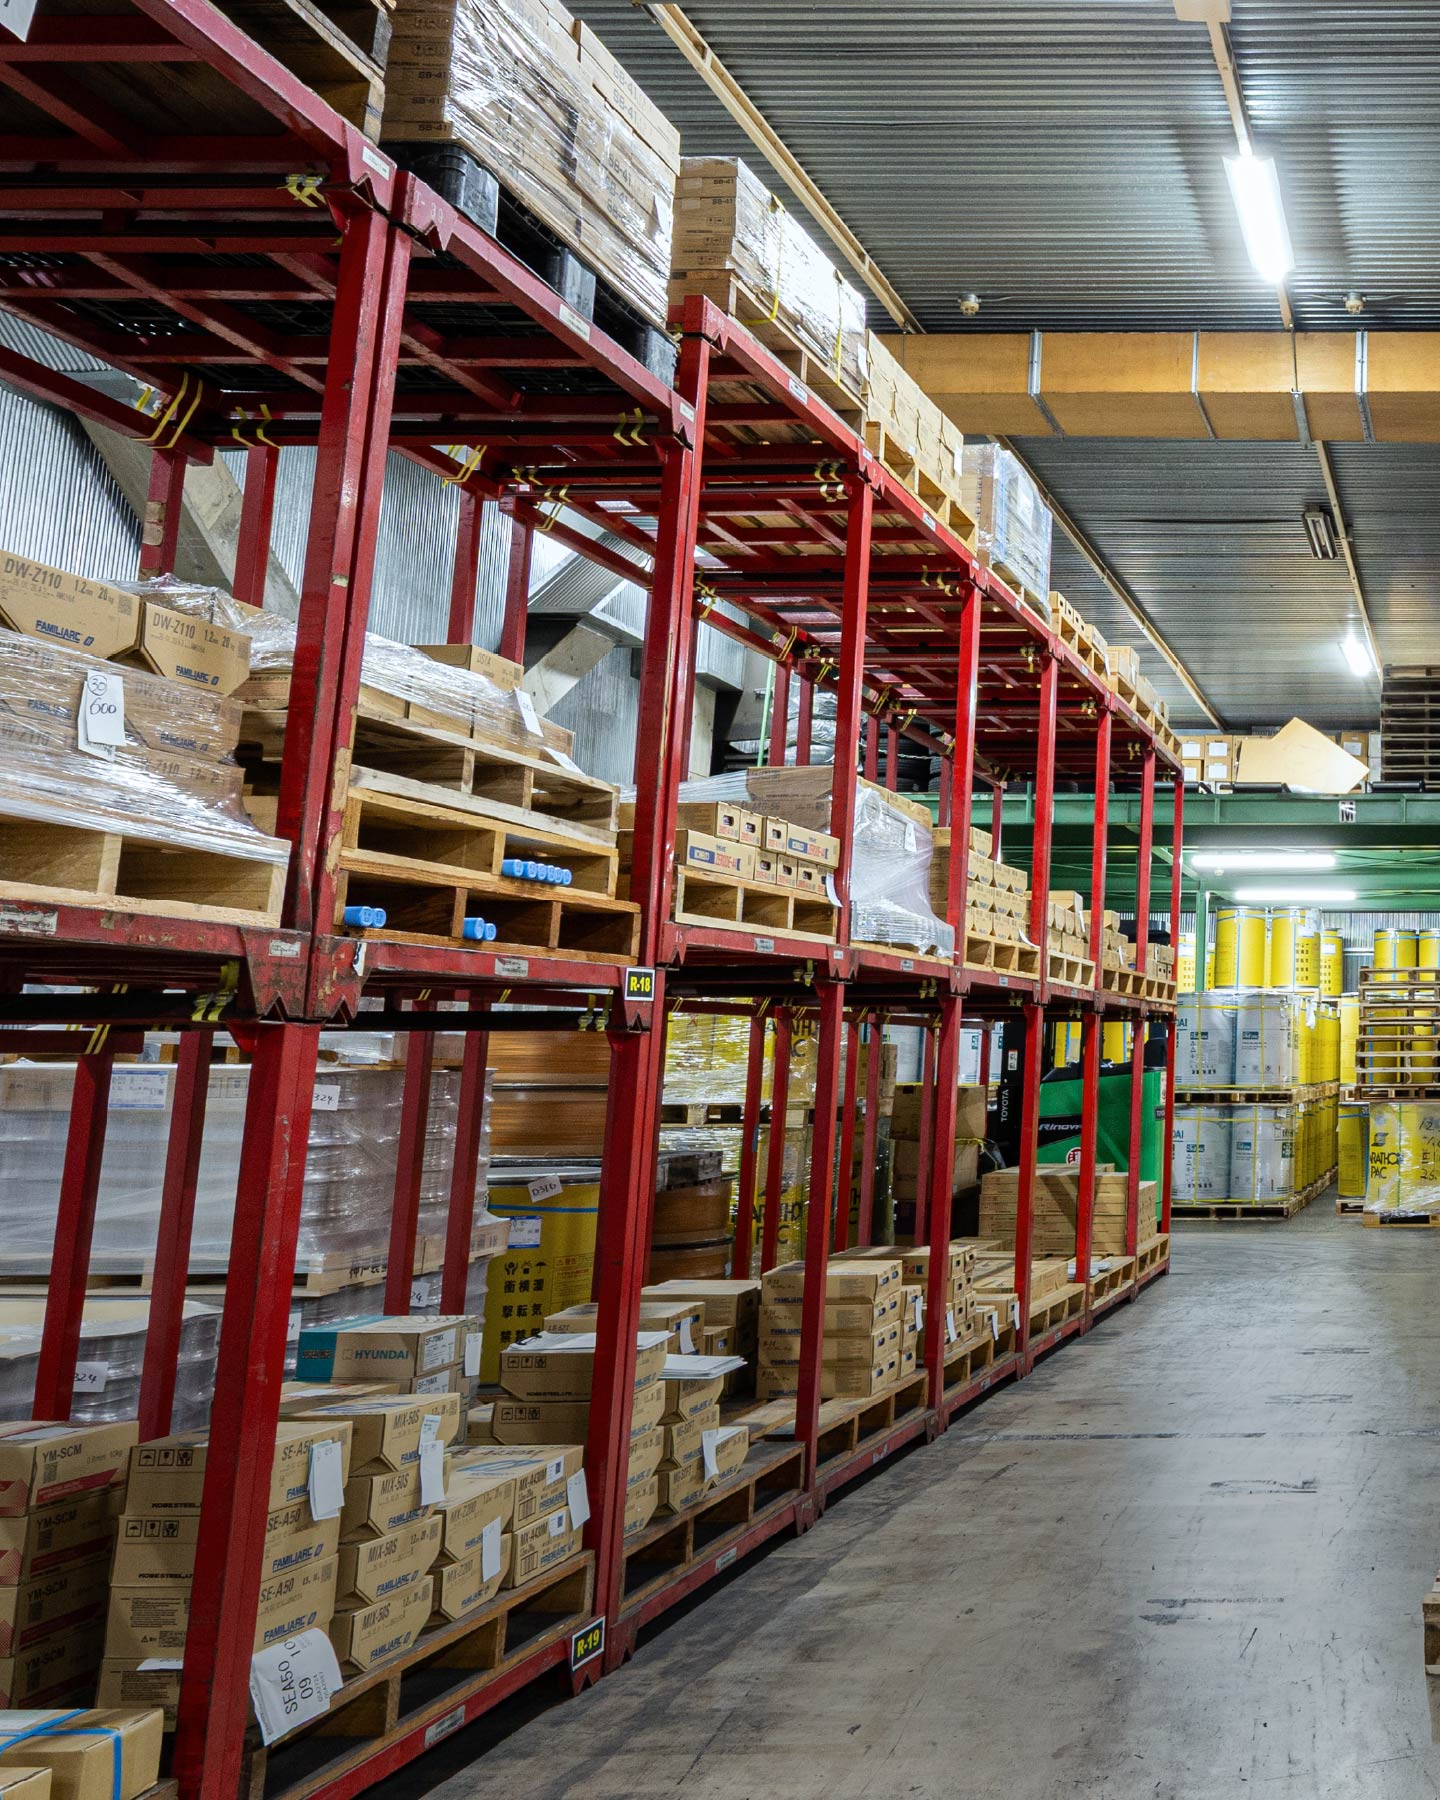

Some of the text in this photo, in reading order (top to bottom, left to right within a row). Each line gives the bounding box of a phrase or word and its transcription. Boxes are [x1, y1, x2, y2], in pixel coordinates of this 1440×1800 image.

[4, 558, 62, 589] DW-Z110
[36, 620, 81, 643] FAMILIARC
[153, 612, 196, 638] DW-Z110
[176, 665, 209, 684] FAMILIARC
[629, 976, 651, 993] R-18
[1001, 1089, 1009, 1122] TOYOTA
[1371, 1166, 1387, 1179] PAC
[355, 1350, 409, 1360] HYUNDAI
[393, 1409, 420, 1430] MIX-50S
[42, 1443, 83, 1463] YM-SCM
[281, 1438, 314, 1461] SE-A50
[381, 1473, 409, 1495] MIX-50S
[36, 1509, 77, 1532] YM-SCM
[267, 1509, 301, 1533] SE-A50
[388, 1508, 420, 1530] FAMILIARC
[272, 1546, 313, 1573] FAMILIARC
[367, 1538, 398, 1564] MIX-50S
[27, 1578, 68, 1602] YM-SCM
[261, 1580, 295, 1603] SE-A50
[376, 1572, 411, 1598] FAMILIARC
[362, 1602, 391, 1630] MIX-50S
[263, 1614, 309, 1644] FAMILIARC
[370, 1636, 403, 1663] FAMILIARC
[576, 1629, 601, 1656] R-19
[24, 1646, 66, 1672] YM-SCM
[277, 1660, 298, 1716] SEA50
[298, 1675, 314, 1700] 09
